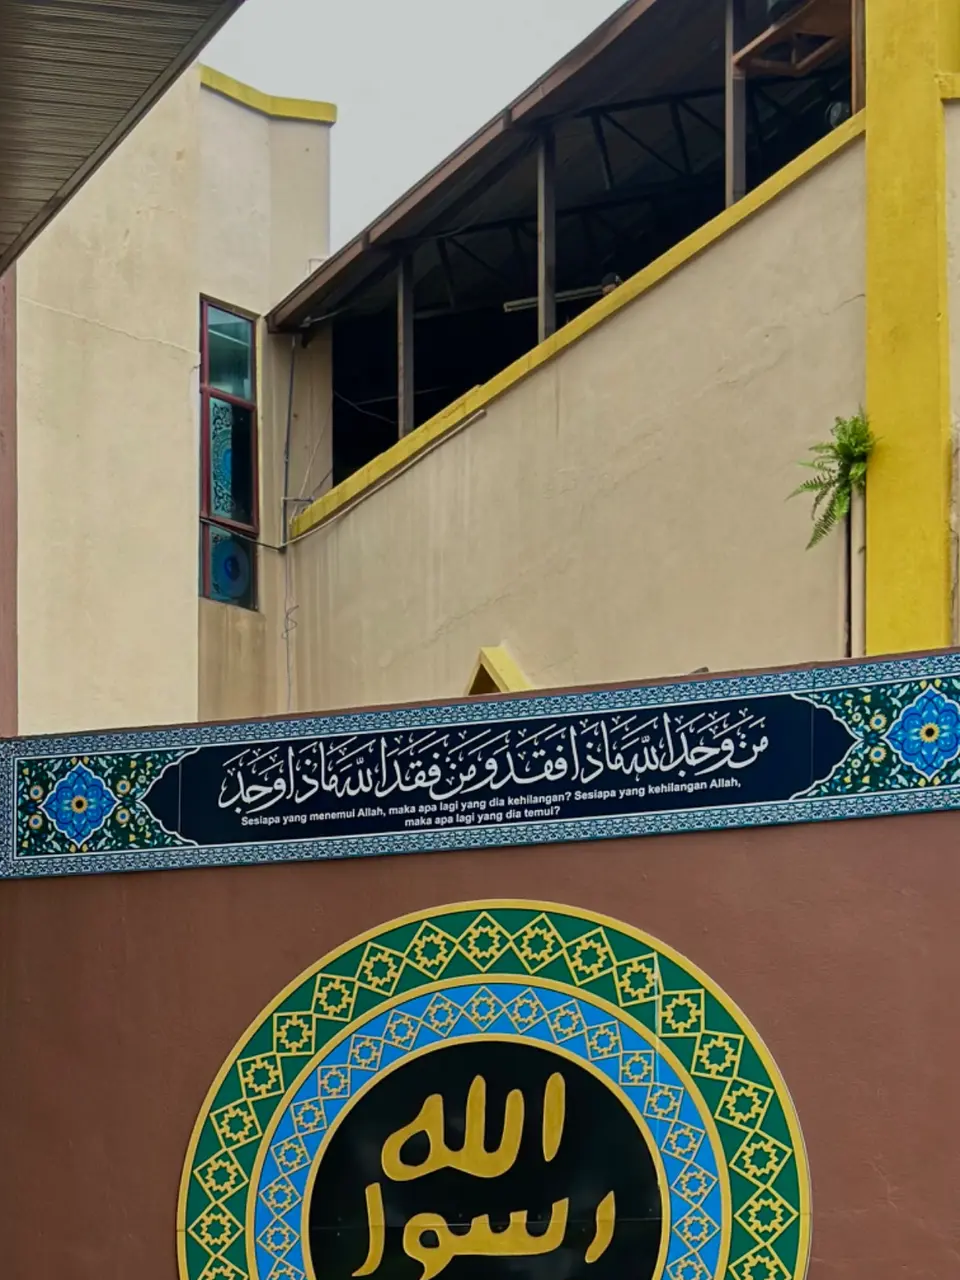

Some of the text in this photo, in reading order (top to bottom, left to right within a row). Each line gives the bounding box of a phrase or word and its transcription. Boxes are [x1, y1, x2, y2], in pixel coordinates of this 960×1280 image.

[241, 776, 742, 826] Sesiapa yang menemui Allah, maka apa lagi yang dia kehilangan? Sesiapa yang kehilangan Allah,
[405, 805, 560, 827] maka apa lagi yang dia temui?
[381, 1071, 565, 1182] الله
